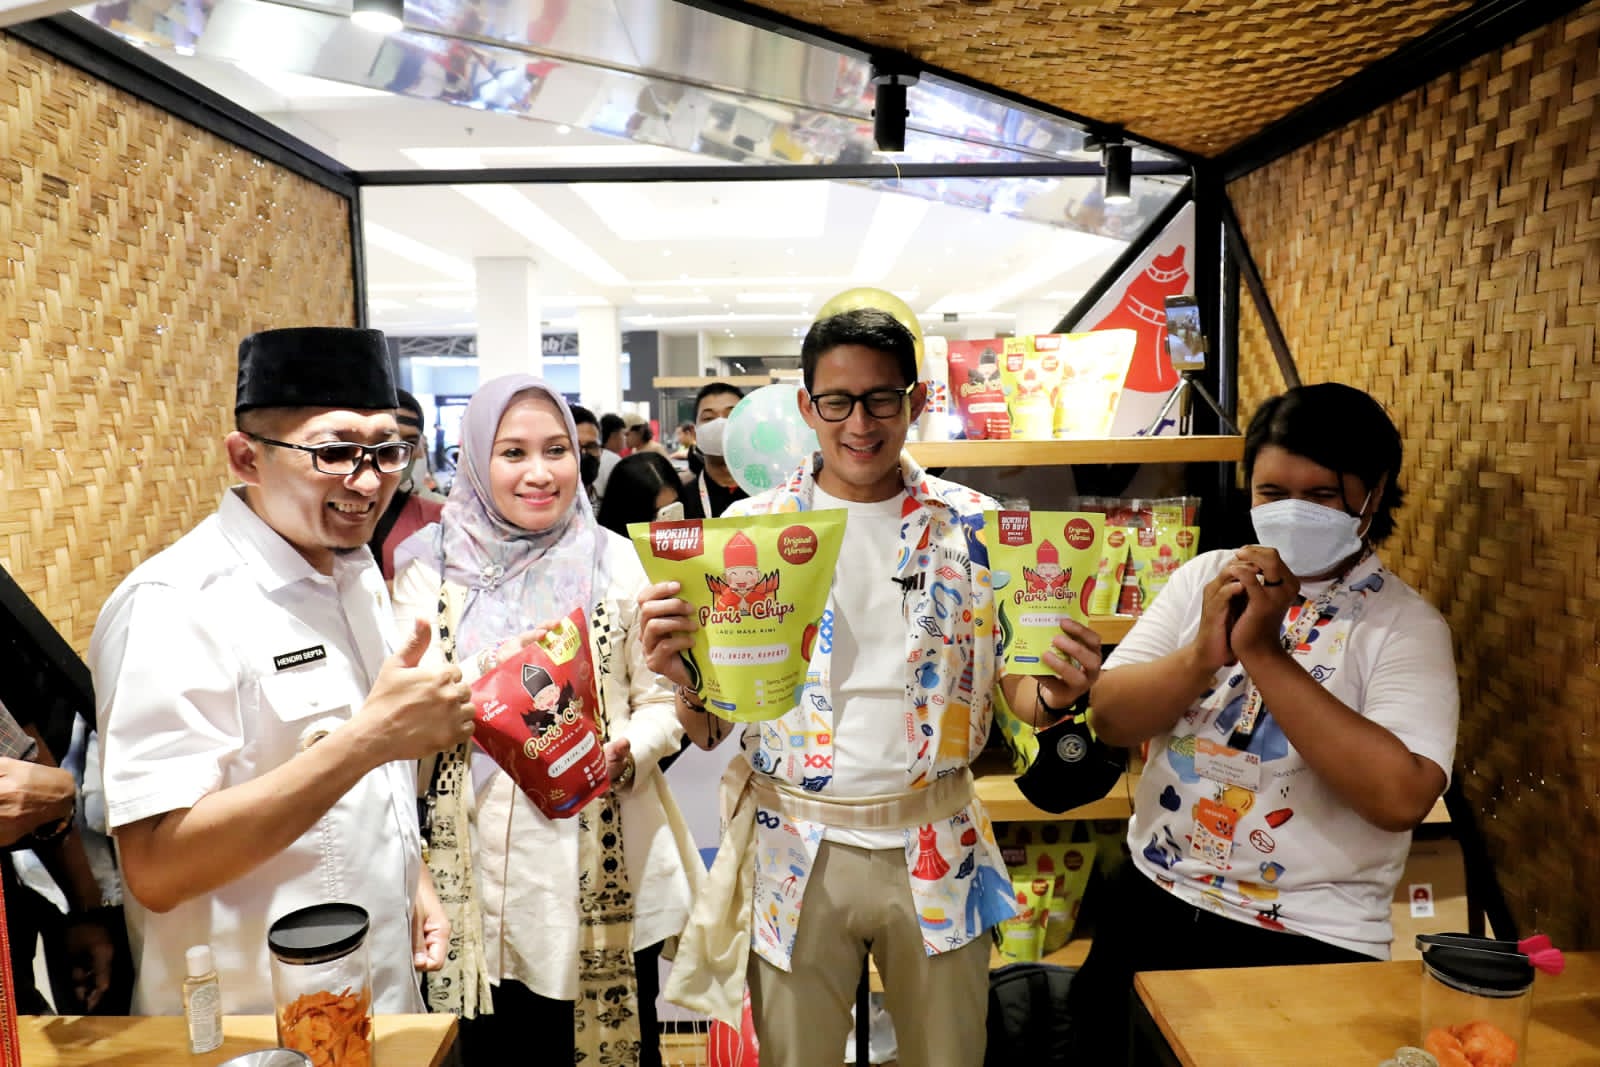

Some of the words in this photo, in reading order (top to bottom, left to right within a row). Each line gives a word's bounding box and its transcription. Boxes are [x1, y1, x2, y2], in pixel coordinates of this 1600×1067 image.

[655, 527, 689, 540] WORTH
[690, 526, 700, 538] IT
[1001, 523, 1011, 531] TO
[1012, 523, 1029, 531] BUY!
[655, 539, 669, 551] TO
[671, 537, 699, 550] BUY!
[783, 535, 813, 548] Original
[1014, 589, 1048, 606] Paris
[698, 605, 742, 628] Paris
[752, 597, 796, 625] Chips
[276, 653, 303, 667] HENDRI
[303, 648, 324, 660] SEPTA
[523, 724, 563, 760] Paris
